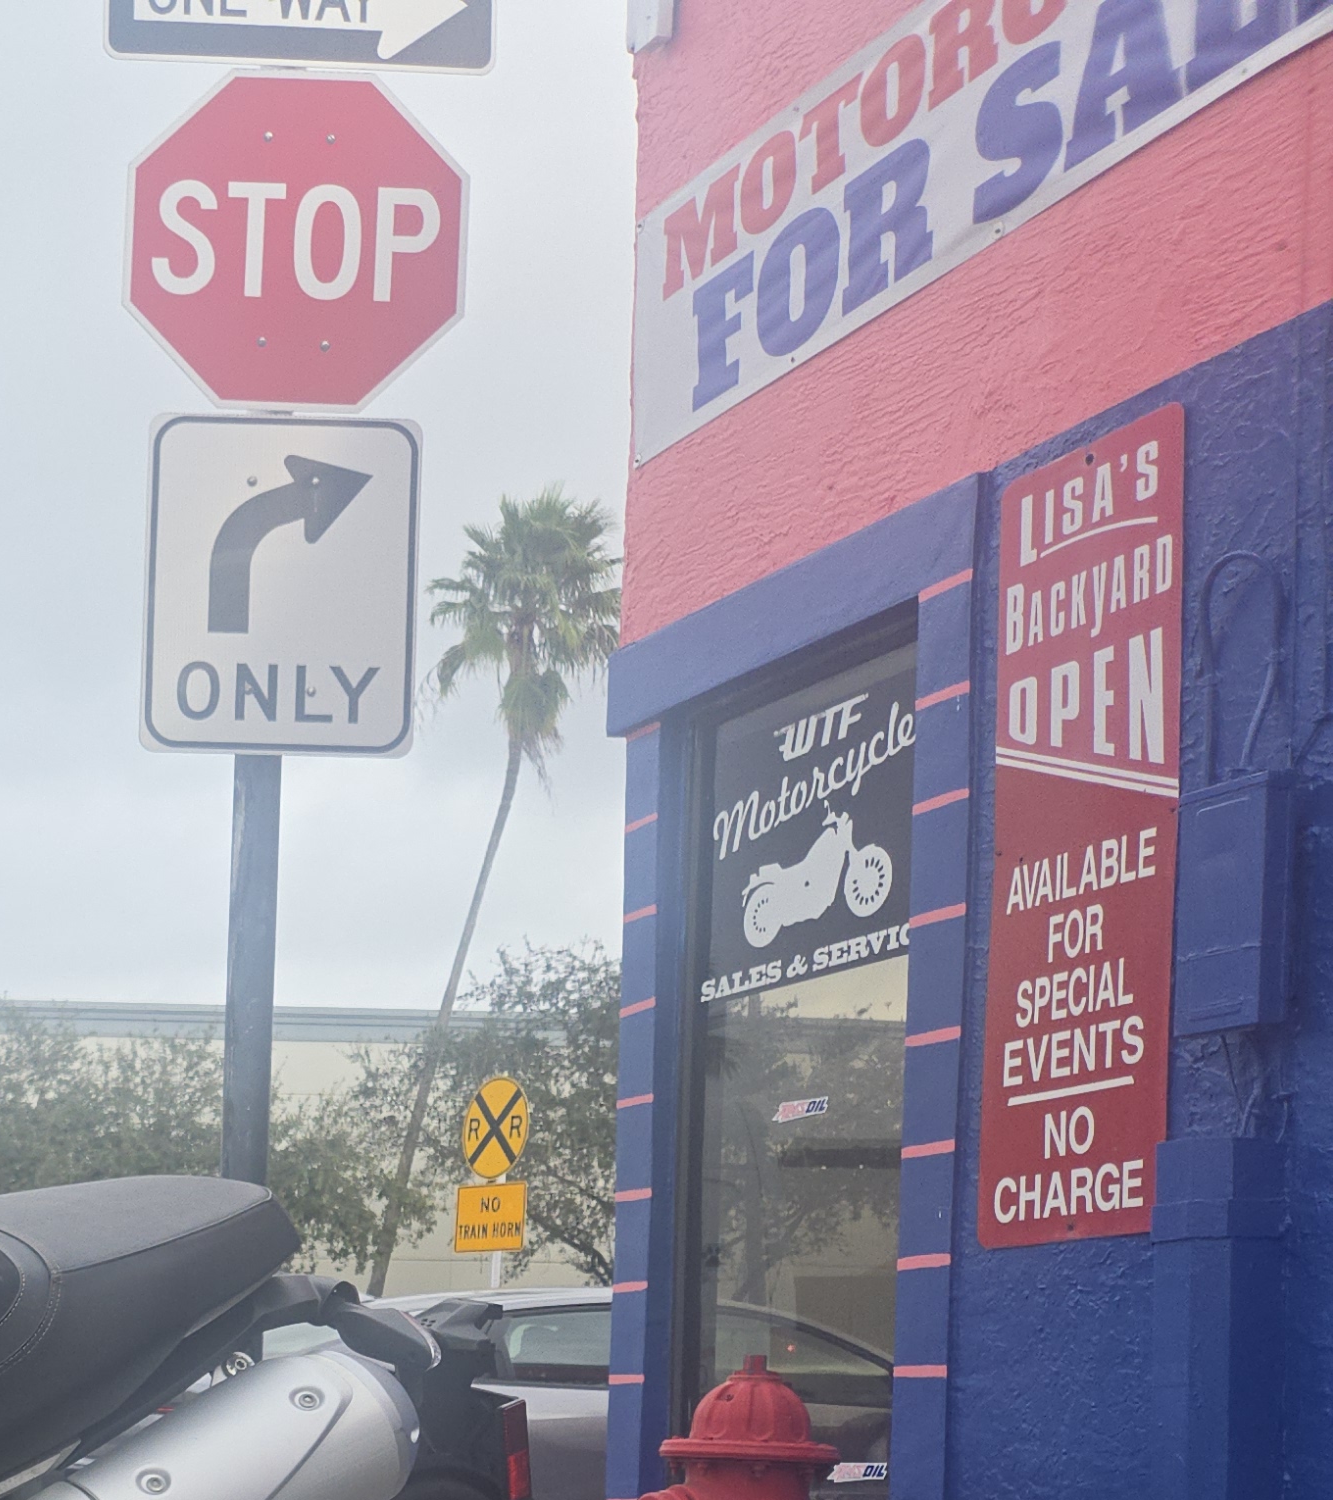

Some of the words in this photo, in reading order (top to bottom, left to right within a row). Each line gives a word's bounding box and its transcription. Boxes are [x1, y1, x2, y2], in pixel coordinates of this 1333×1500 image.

[151, 179, 440, 302] STOP
[692, 138, 933, 412] FOR
[973, 0, 1333, 225] SAL
[1020, 440, 1158, 567] LISA'S
[1005, 534, 1173, 655] BACKYARD
[177, 660, 381, 724] ONLY
[1009, 627, 1165, 764] OPEN
[774, 693, 869, 762] WTF
[1006, 827, 1157, 915] AVAILABLE
[1048, 904, 1103, 963] FOR
[701, 960, 782, 1002] SALES
[786, 954, 808, 978] &
[1015, 958, 1134, 1028] SPECIAL
[1003, 1016, 1144, 1087] EVENTS
[1044, 1106, 1095, 1159] NO
[480, 1197, 501, 1212] NO
[994, 1159, 1144, 1224] CHARGE
[459, 1223, 488, 1240] TRAIN
[492, 1221, 522, 1238] HORN
